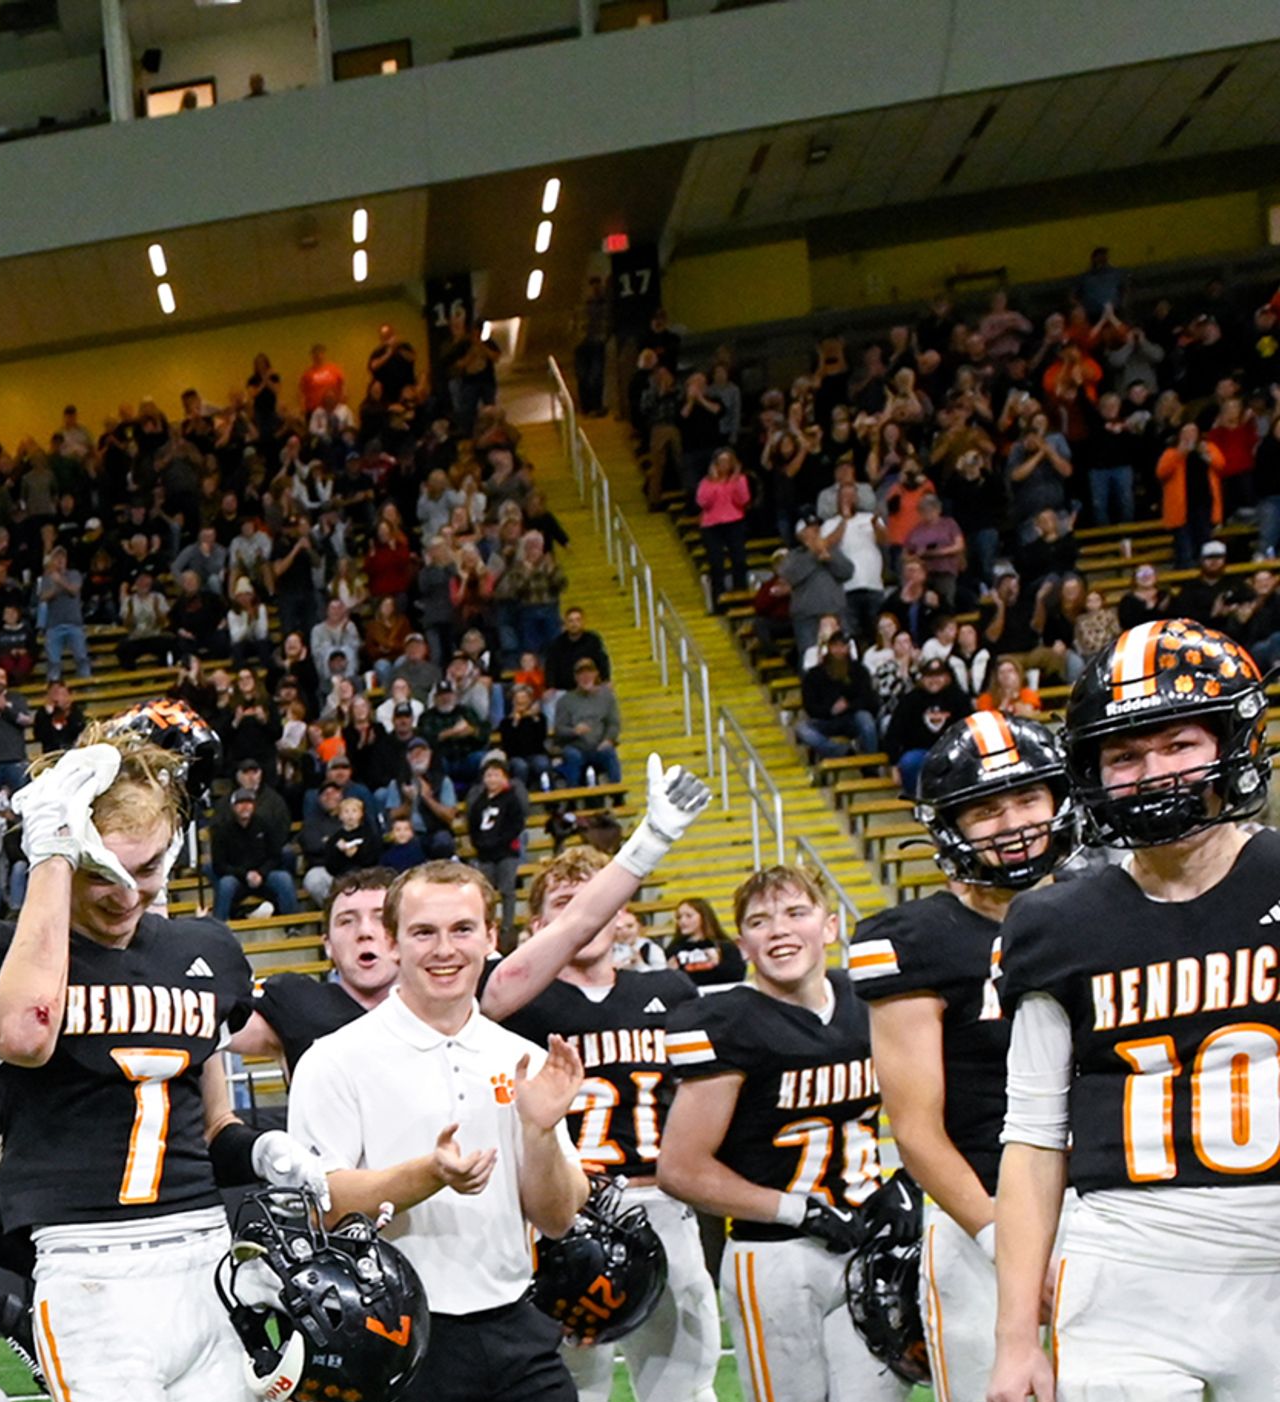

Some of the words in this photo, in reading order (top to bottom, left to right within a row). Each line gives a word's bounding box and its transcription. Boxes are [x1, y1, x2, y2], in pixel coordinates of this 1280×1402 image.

[618, 270, 652, 296] 17
[63, 985, 216, 1039] KENDRICK
[1092, 945, 1280, 1031] KENDRIC
[109, 1047, 191, 1205] 7
[566, 1071, 663, 1165] 21
[1114, 1022, 1280, 1183] 10
